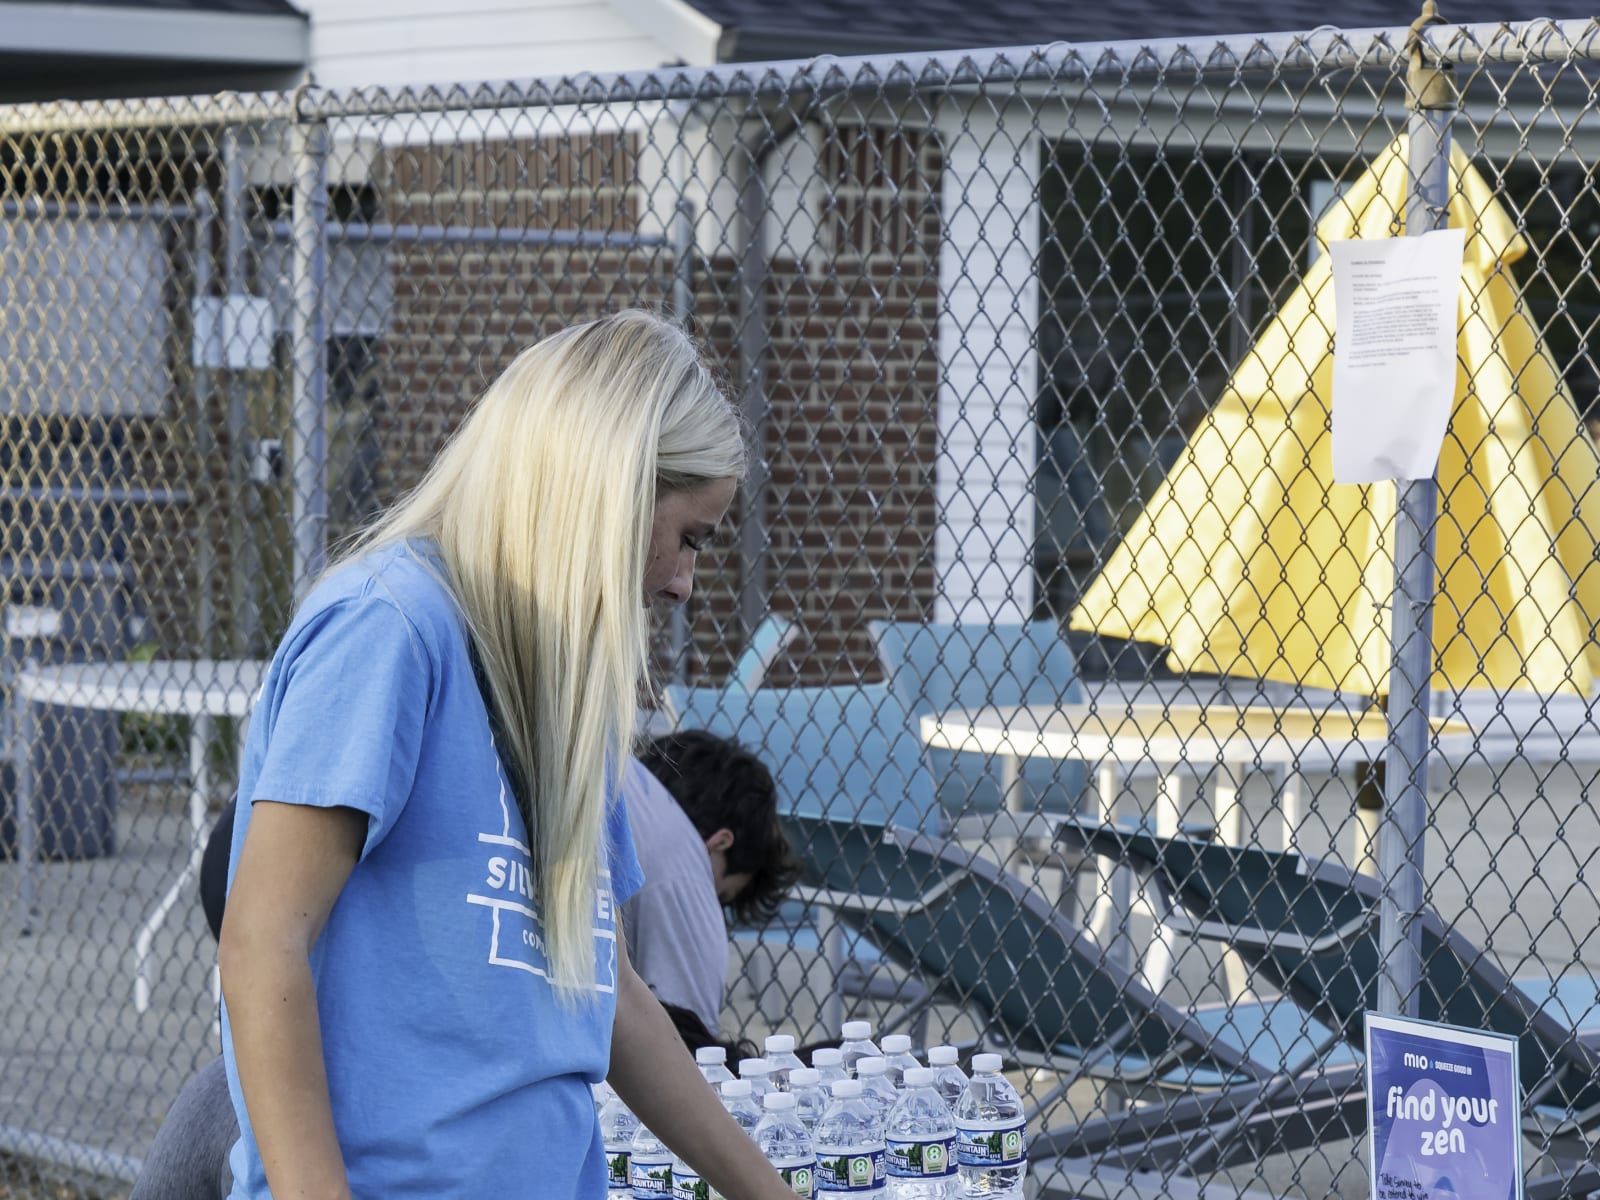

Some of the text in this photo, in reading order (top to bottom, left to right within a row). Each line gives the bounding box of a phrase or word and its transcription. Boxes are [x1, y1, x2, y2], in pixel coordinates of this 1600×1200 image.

[1386, 1085, 1498, 1128] find your
[1420, 1128, 1466, 1156] zen
